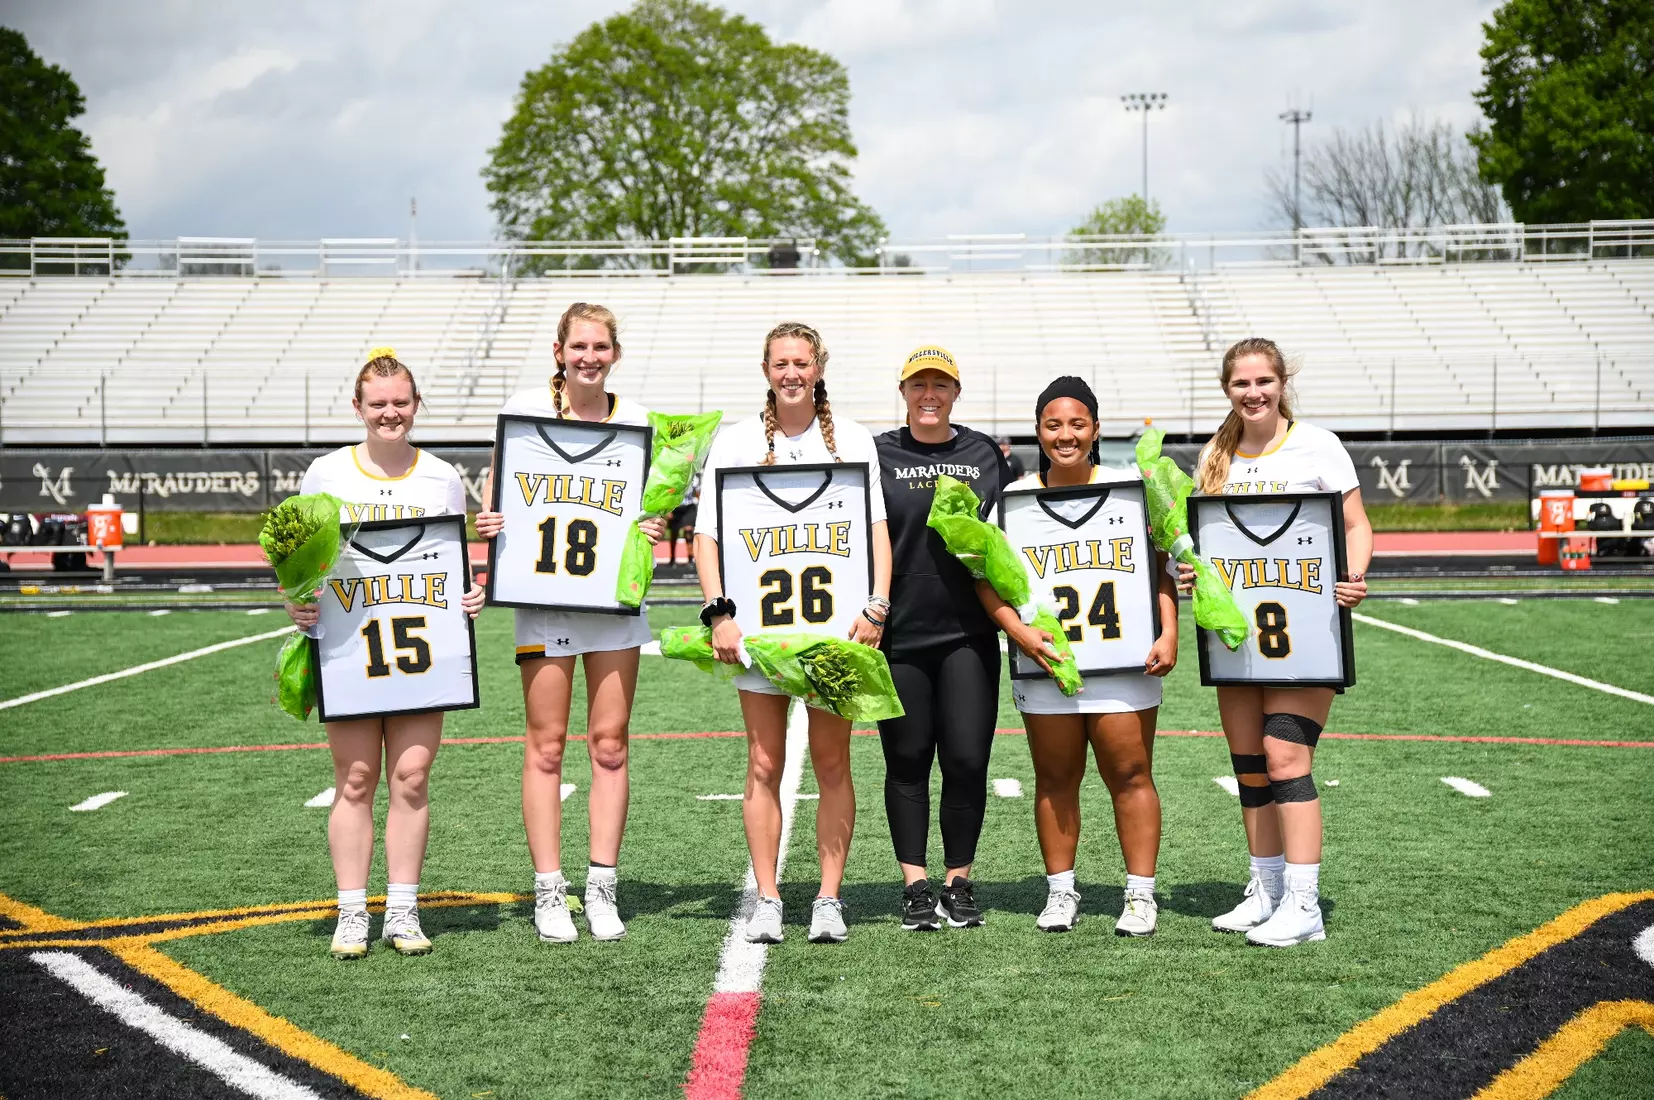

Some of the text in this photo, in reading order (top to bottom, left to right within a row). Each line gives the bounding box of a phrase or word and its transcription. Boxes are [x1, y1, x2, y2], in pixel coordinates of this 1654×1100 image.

[514, 471, 627, 517] VILLE
[894, 464, 980, 479] MARAUDERS
[534, 515, 599, 578] 18
[739, 520, 851, 562] VILLE
[1022, 537, 1135, 579] VILLE
[328, 572, 448, 612] VILLE
[758, 564, 834, 628] 26
[1211, 557, 1322, 595] VILLE
[1053, 580, 1123, 643] 24
[1254, 600, 1292, 660] 8
[360, 615, 433, 679] 15
